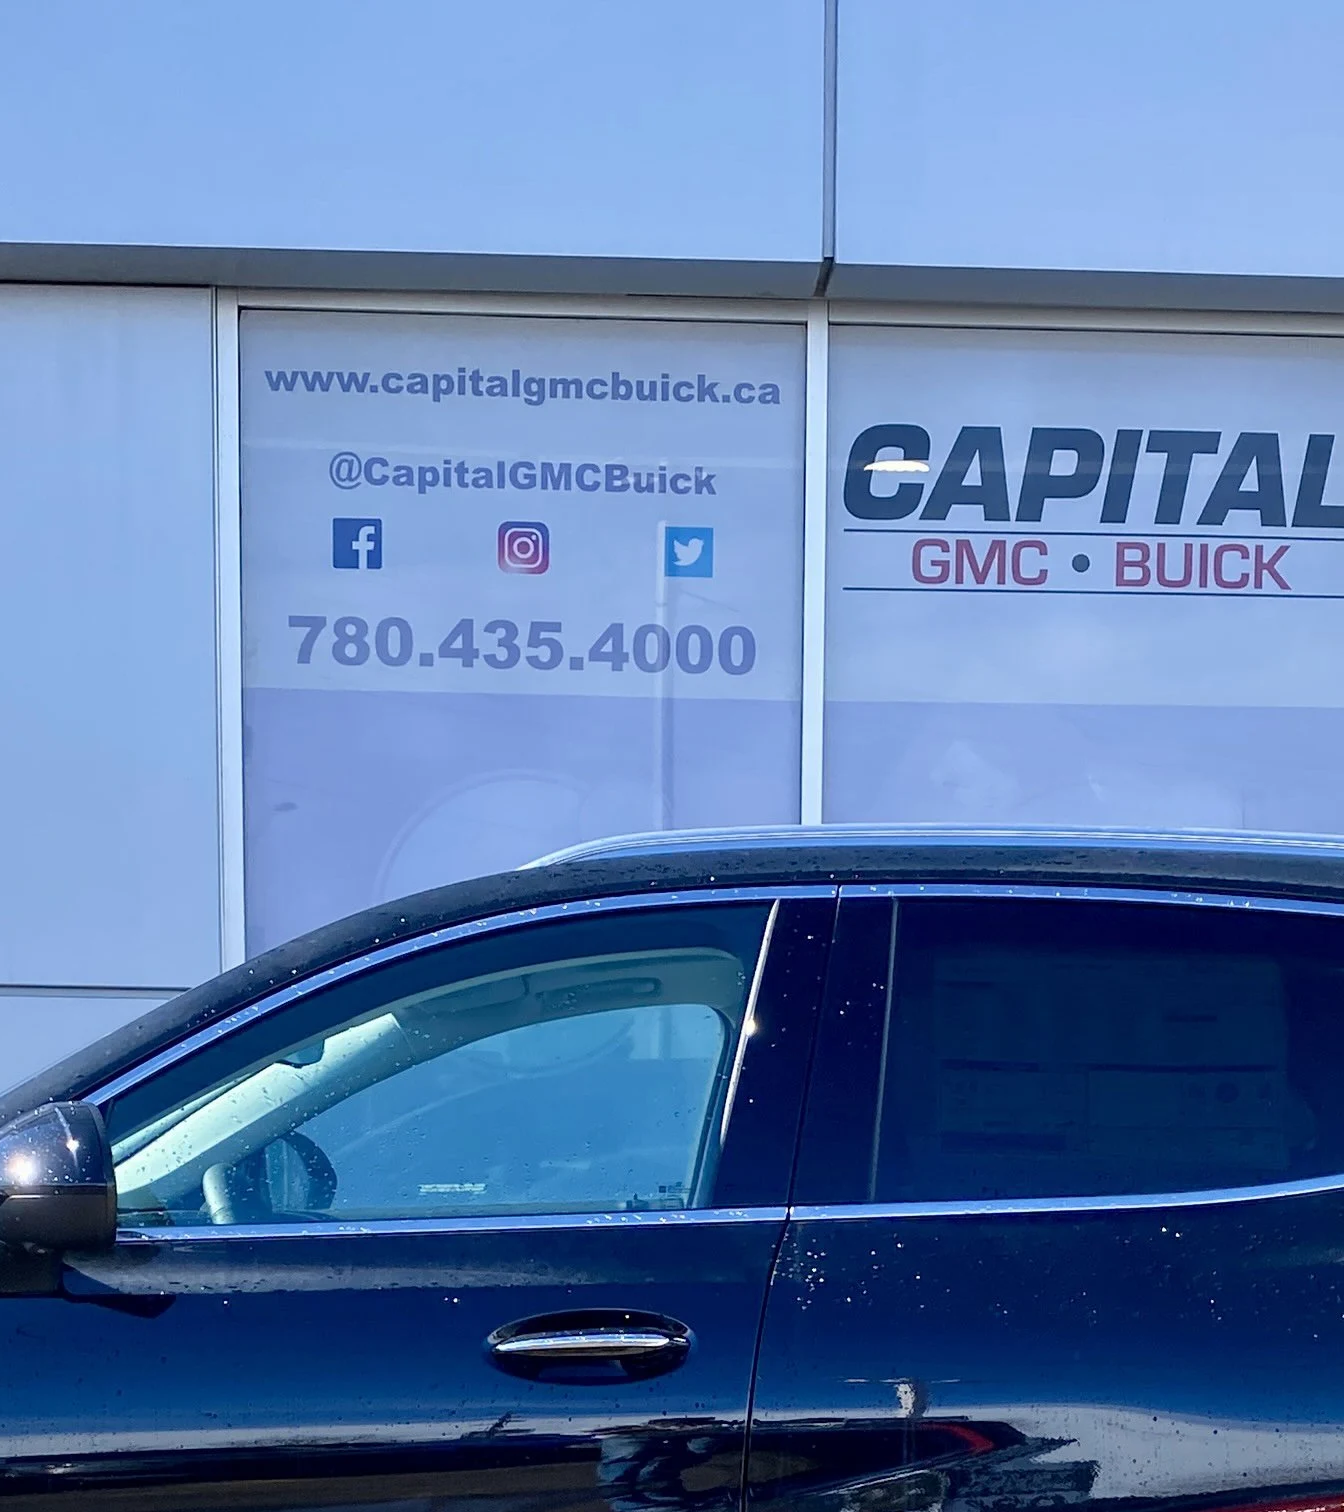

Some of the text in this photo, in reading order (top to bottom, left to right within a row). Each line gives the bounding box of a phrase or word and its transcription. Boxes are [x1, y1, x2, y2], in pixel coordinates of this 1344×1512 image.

[264, 367, 781, 406] www.capitalgmcbuick.ca
[328, 452, 716, 496] @CapitalGMCBuick
[912, 538, 1291, 590] GMC BUICK
[287, 614, 756, 676] 780.435.4000
